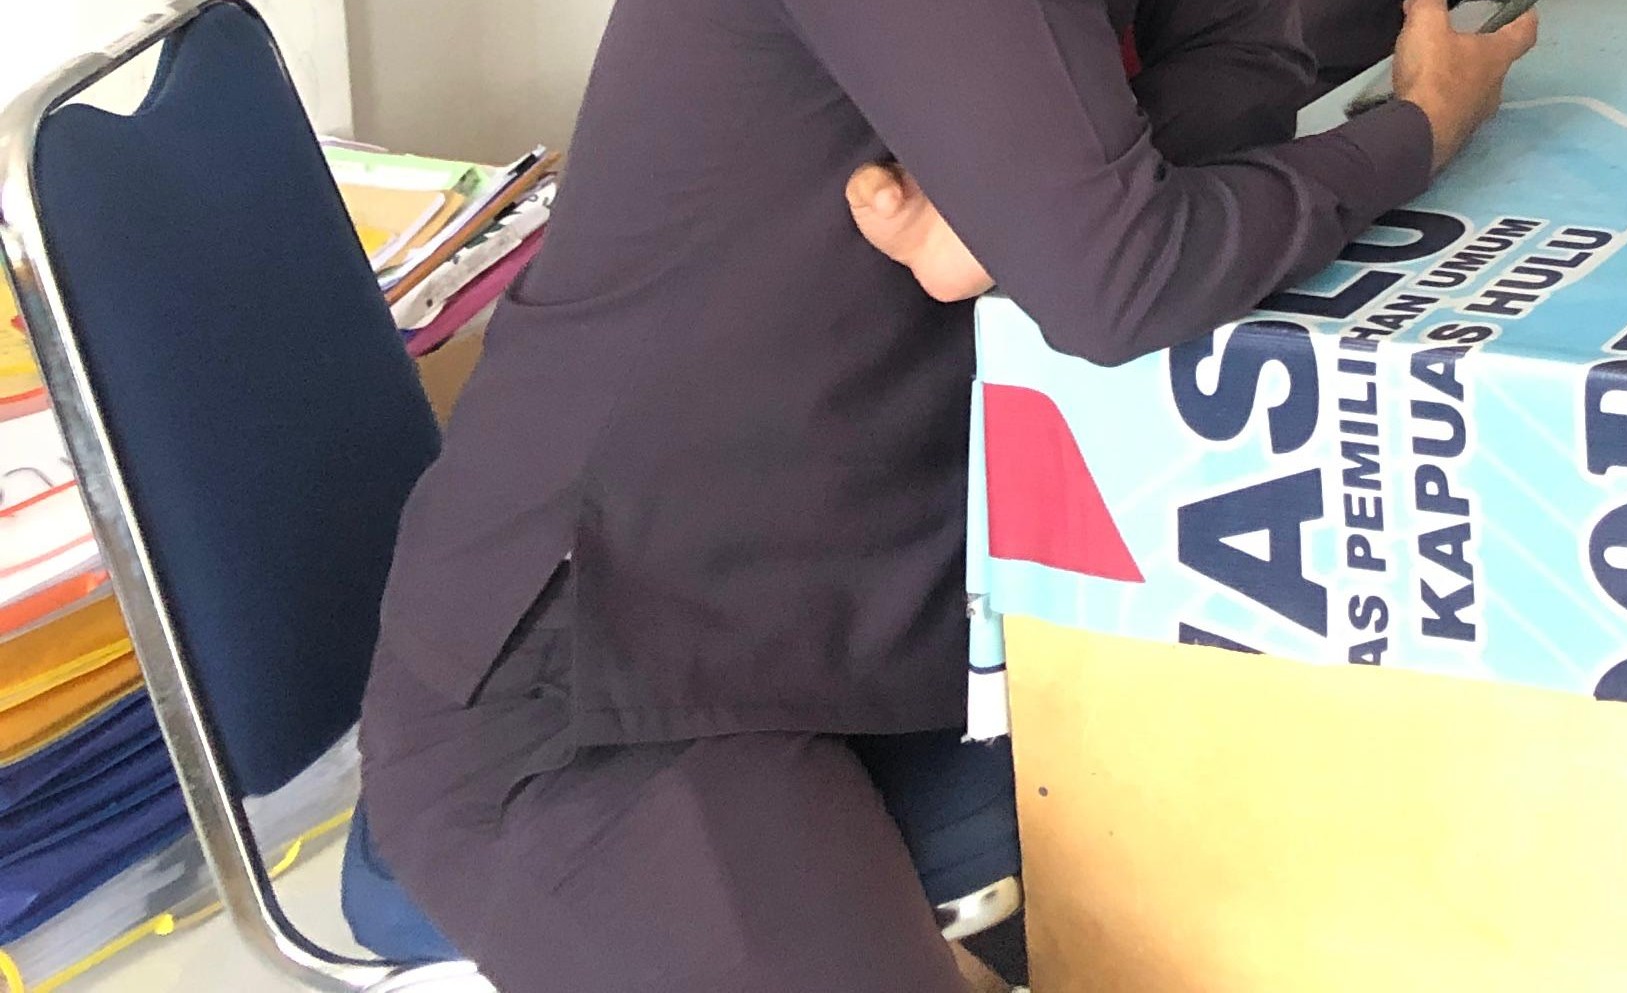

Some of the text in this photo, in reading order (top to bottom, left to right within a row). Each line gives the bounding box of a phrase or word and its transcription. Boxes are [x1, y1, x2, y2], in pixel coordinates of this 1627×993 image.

[1168, 209, 1467, 654] ASLU
[1337, 293, 1440, 572] PEMILIHAN
[1415, 217, 1540, 288] UMUM
[1409, 227, 1613, 642] KAPUAS HULU
